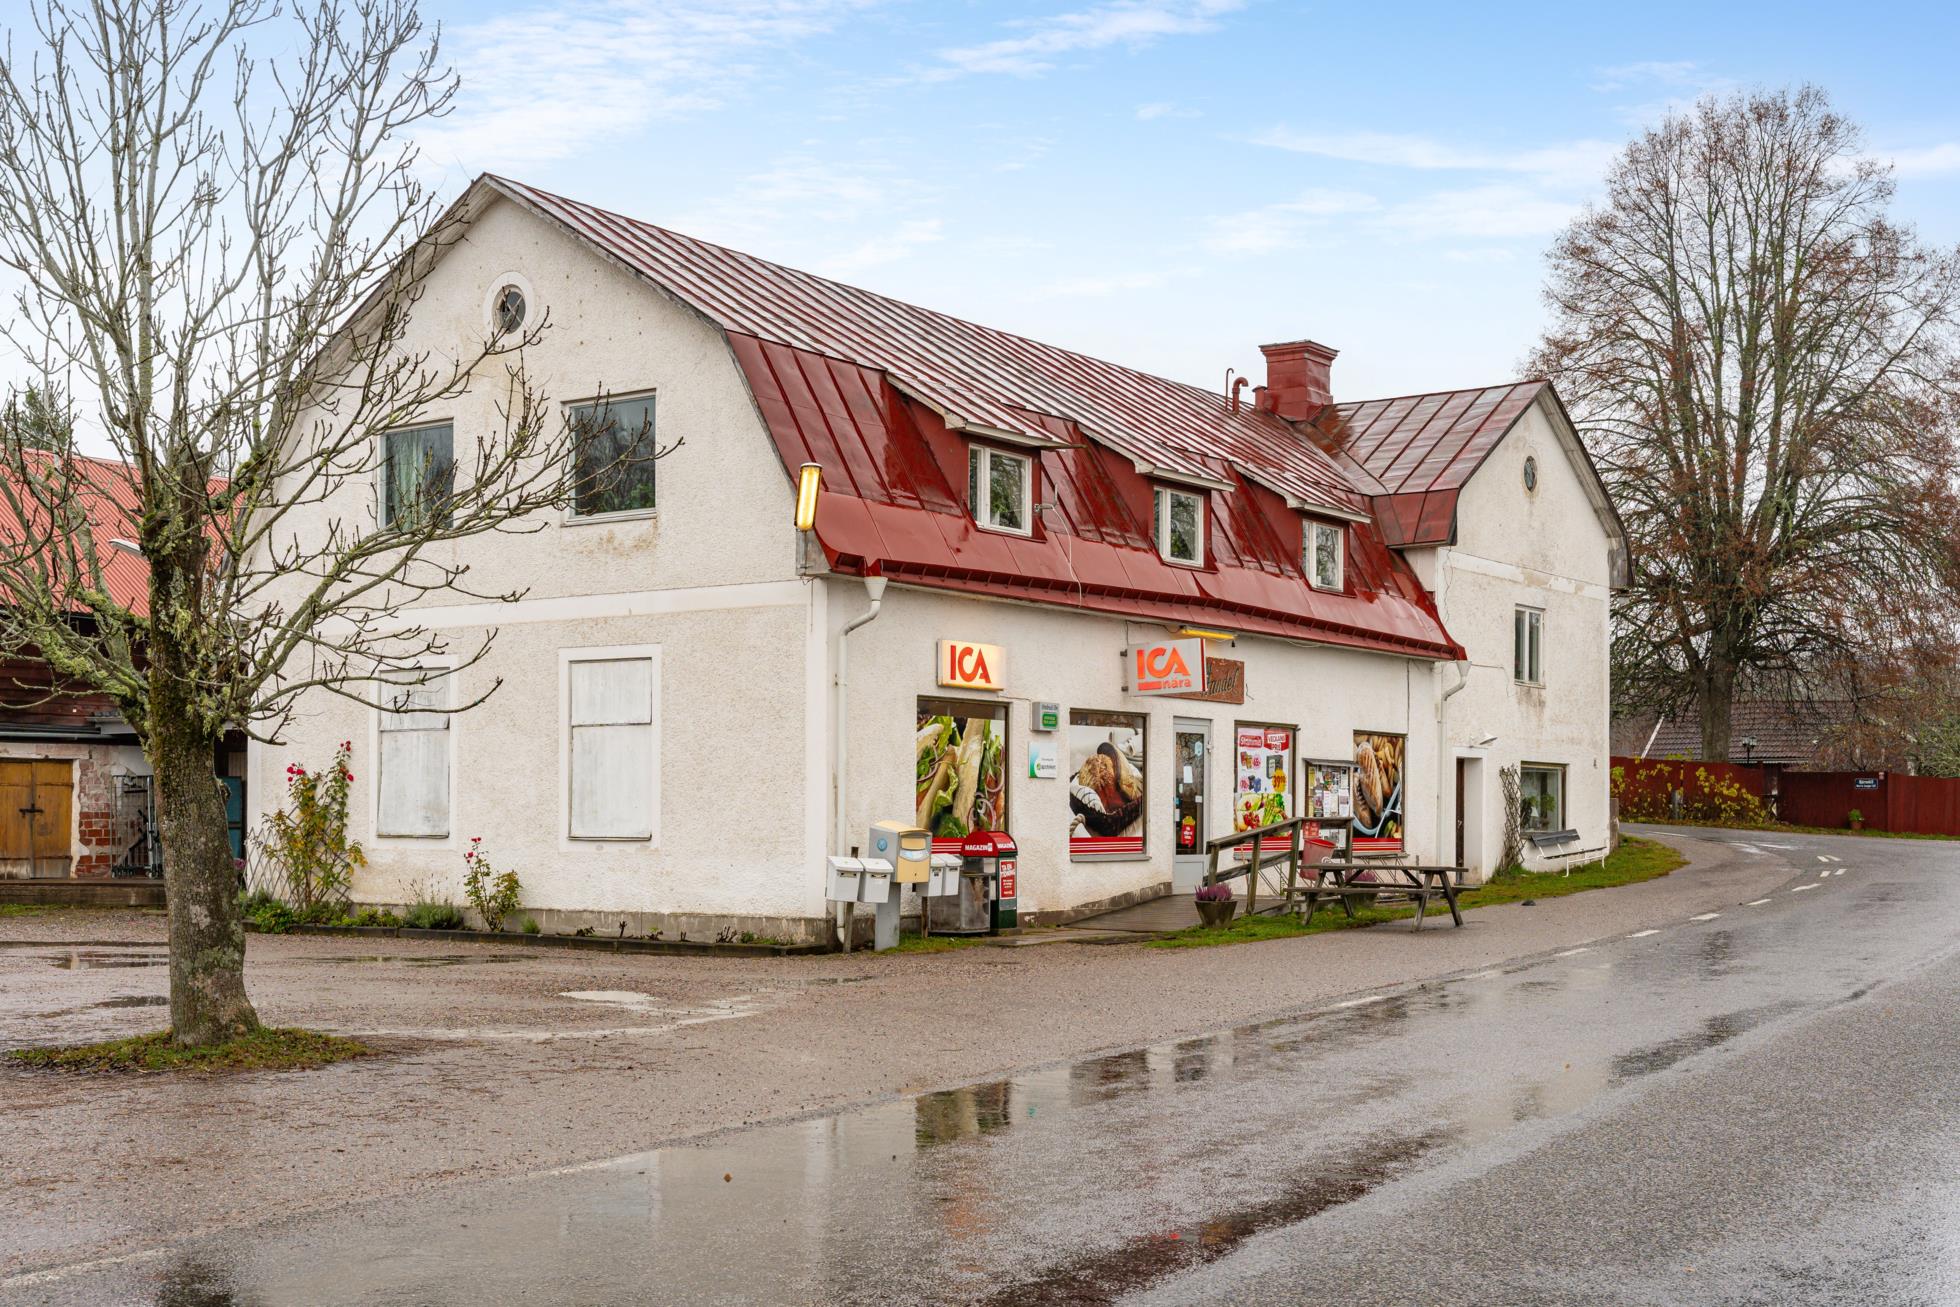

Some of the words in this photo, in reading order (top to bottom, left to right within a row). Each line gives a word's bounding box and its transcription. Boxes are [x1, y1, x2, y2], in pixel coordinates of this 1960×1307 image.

[950, 645, 992, 684] ICA
[1136, 646, 1191, 679] ICA
[1162, 677, 1191, 689] nära
